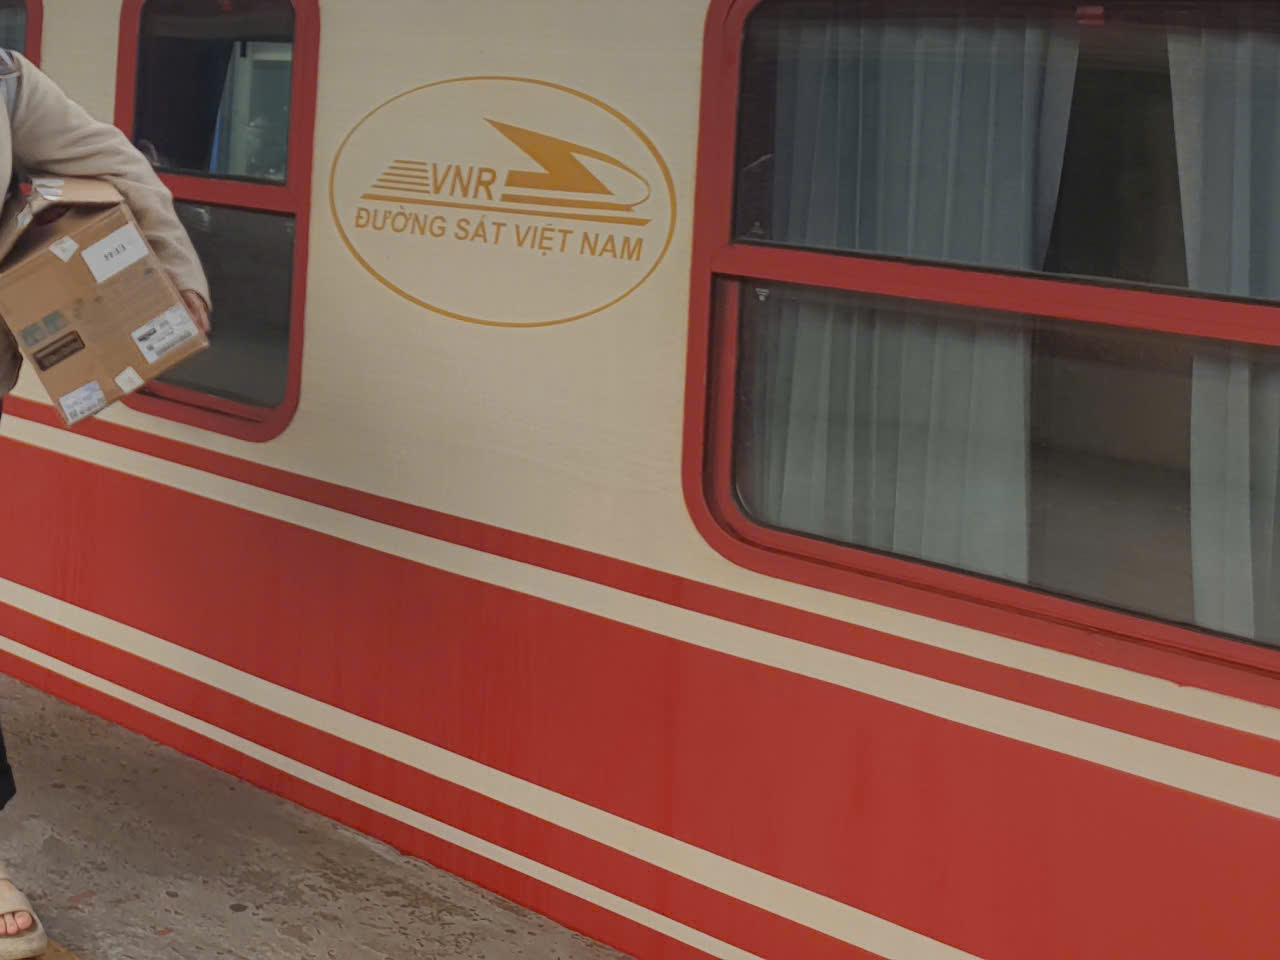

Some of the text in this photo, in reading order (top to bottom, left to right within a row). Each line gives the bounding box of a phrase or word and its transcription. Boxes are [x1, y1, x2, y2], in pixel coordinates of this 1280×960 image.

[431, 163, 497, 200] VNR
[354, 205, 447, 238] ĐƯỜNG
[513, 223, 574, 256] VIỆT
[579, 233, 644, 262] NAM
